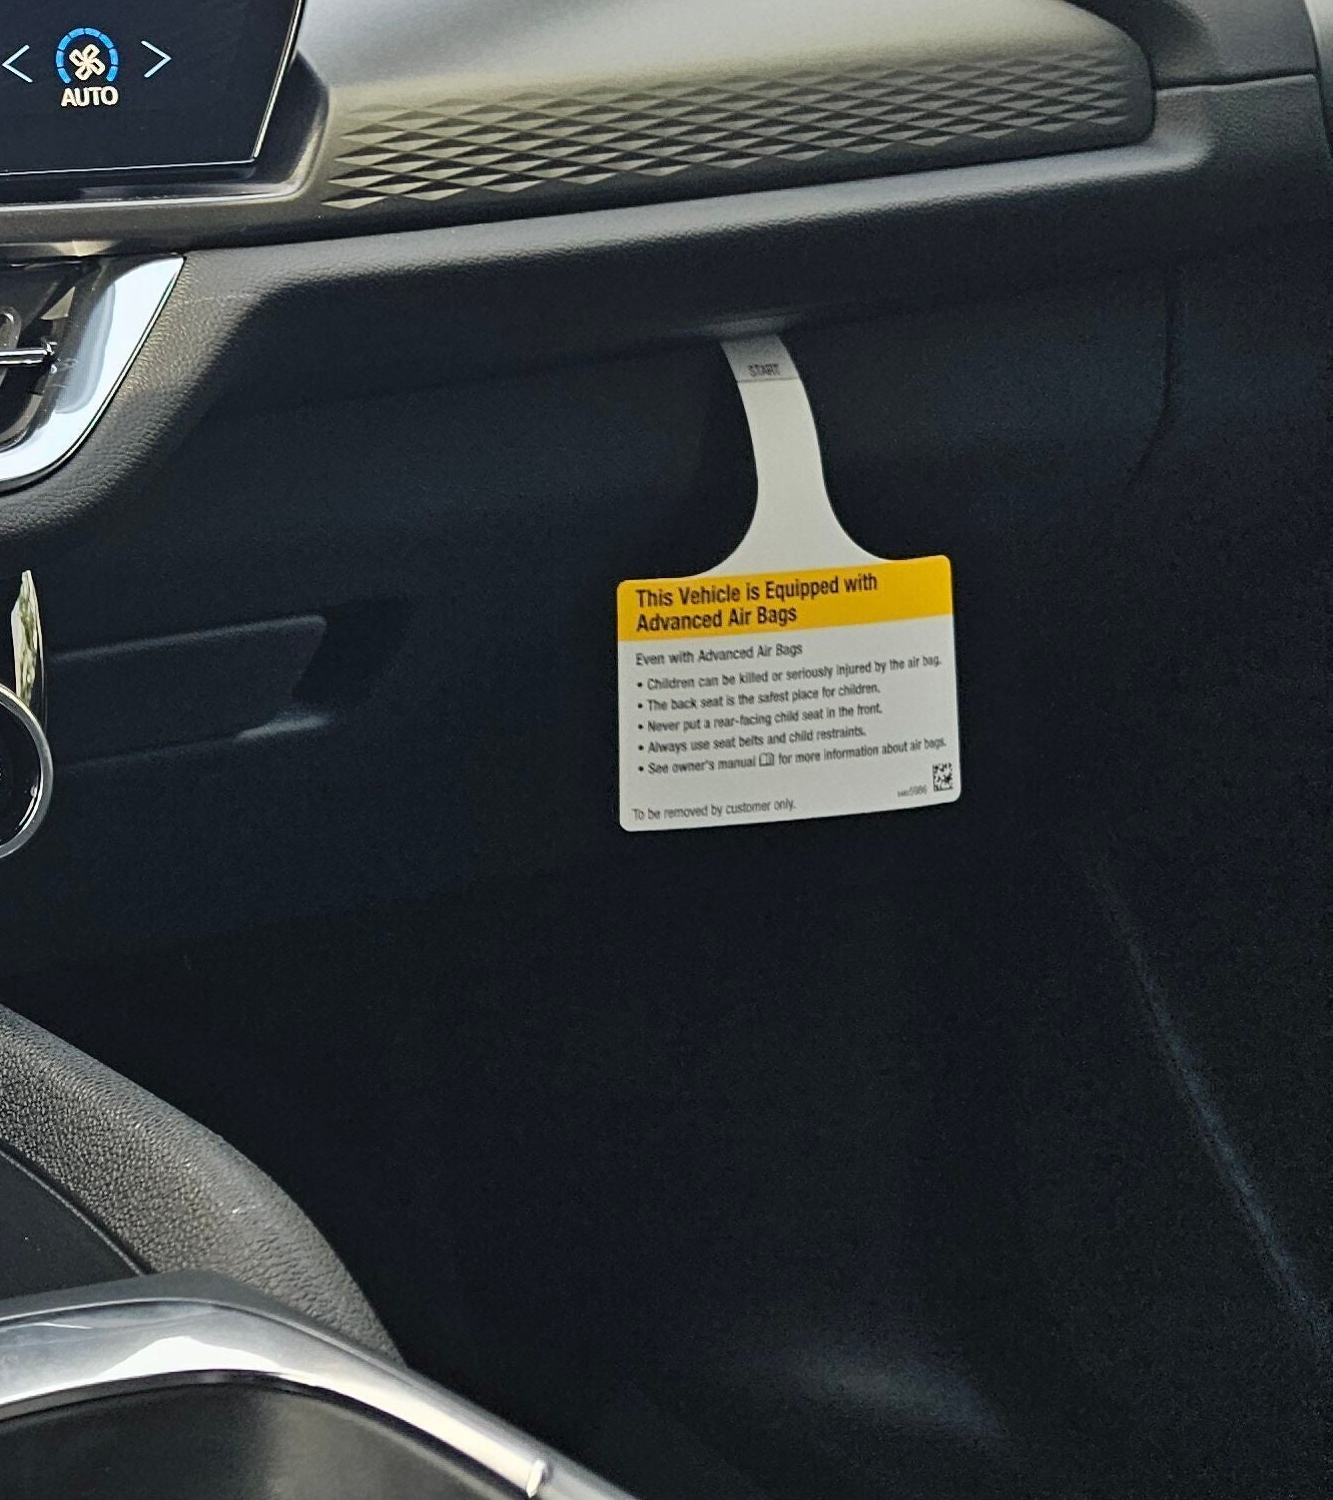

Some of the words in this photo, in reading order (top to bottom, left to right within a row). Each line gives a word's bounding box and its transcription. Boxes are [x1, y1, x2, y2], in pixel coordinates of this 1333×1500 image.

[60, 85, 119, 107] AUTO
[636, 588, 674, 608] This
[679, 584, 741, 605] Vehicle
[746, 582, 760, 600] is
[765, 575, 839, 602] Equipped
[844, 573, 877, 593] with
[636, 609, 723, 632] Advanced
[729, 607, 752, 626] Air
[757, 606, 797, 627] Bags
[635, 652, 665, 666] Even
[668, 650, 694, 664] with
[697, 646, 754, 662] Advanced
[757, 644, 773, 658] Air
[776, 642, 803, 658] Bags
[647, 677, 695, 691] Children
[698, 677, 719, 688] can
[722, 674, 736, 686] be
[739, 670, 769, 684] killed
[772, 671, 783, 682] or
[786, 666, 833, 681] seriously
[836, 662, 872, 677] injured
[874, 660, 887, 674] by
[889, 659, 905, 671] the
[908, 656, 920, 668] air
[923, 655, 942, 667] bag.
[648, 699, 668, 711] The
[671, 698, 697, 710] back
[700, 696, 724, 707] seat
[726, 696, 735, 706] is
[738, 694, 755, 705] the
[758, 690, 789, 704] safest
[792, 688, 819, 702] place
[822, 686, 836, 698] for
[838, 683, 881, 697] children.
[648, 720, 680, 732] Never
[683, 719, 702, 733] put
[704, 719, 711, 728] a
[714, 713, 773, 728] rear-facing
[774, 710, 799, 724] child
[802, 708, 824, 720] seat
[826, 707, 836, 719] in
[839, 706, 855, 717] the
[857, 702, 883, 716] front.
[648, 741, 687, 754] Always
[690, 741, 710, 751] use
[713, 736, 736, 749] seat
[739, 734, 765, 747] belts
[767, 732, 787, 744] and
[789, 729, 814, 743] child
[816, 725, 867, 740] restraints.
[648, 762, 669, 774] See
[672, 759, 715, 773] owner's
[718, 755, 756, 770] manual
[778, 752, 793, 765] for
[795, 750, 821, 764] more
[823, 744, 879, 760] information
[881, 741, 908, 755] about
[910, 739, 922, 751] air
[924, 736, 947, 749] bags.
[632, 808, 645, 821] To
[647, 808, 661, 820] be
[664, 804, 708, 819] removed
[711, 803, 723, 817] by
[725, 800, 771, 814] customer
[773, 797, 797, 811] only.
